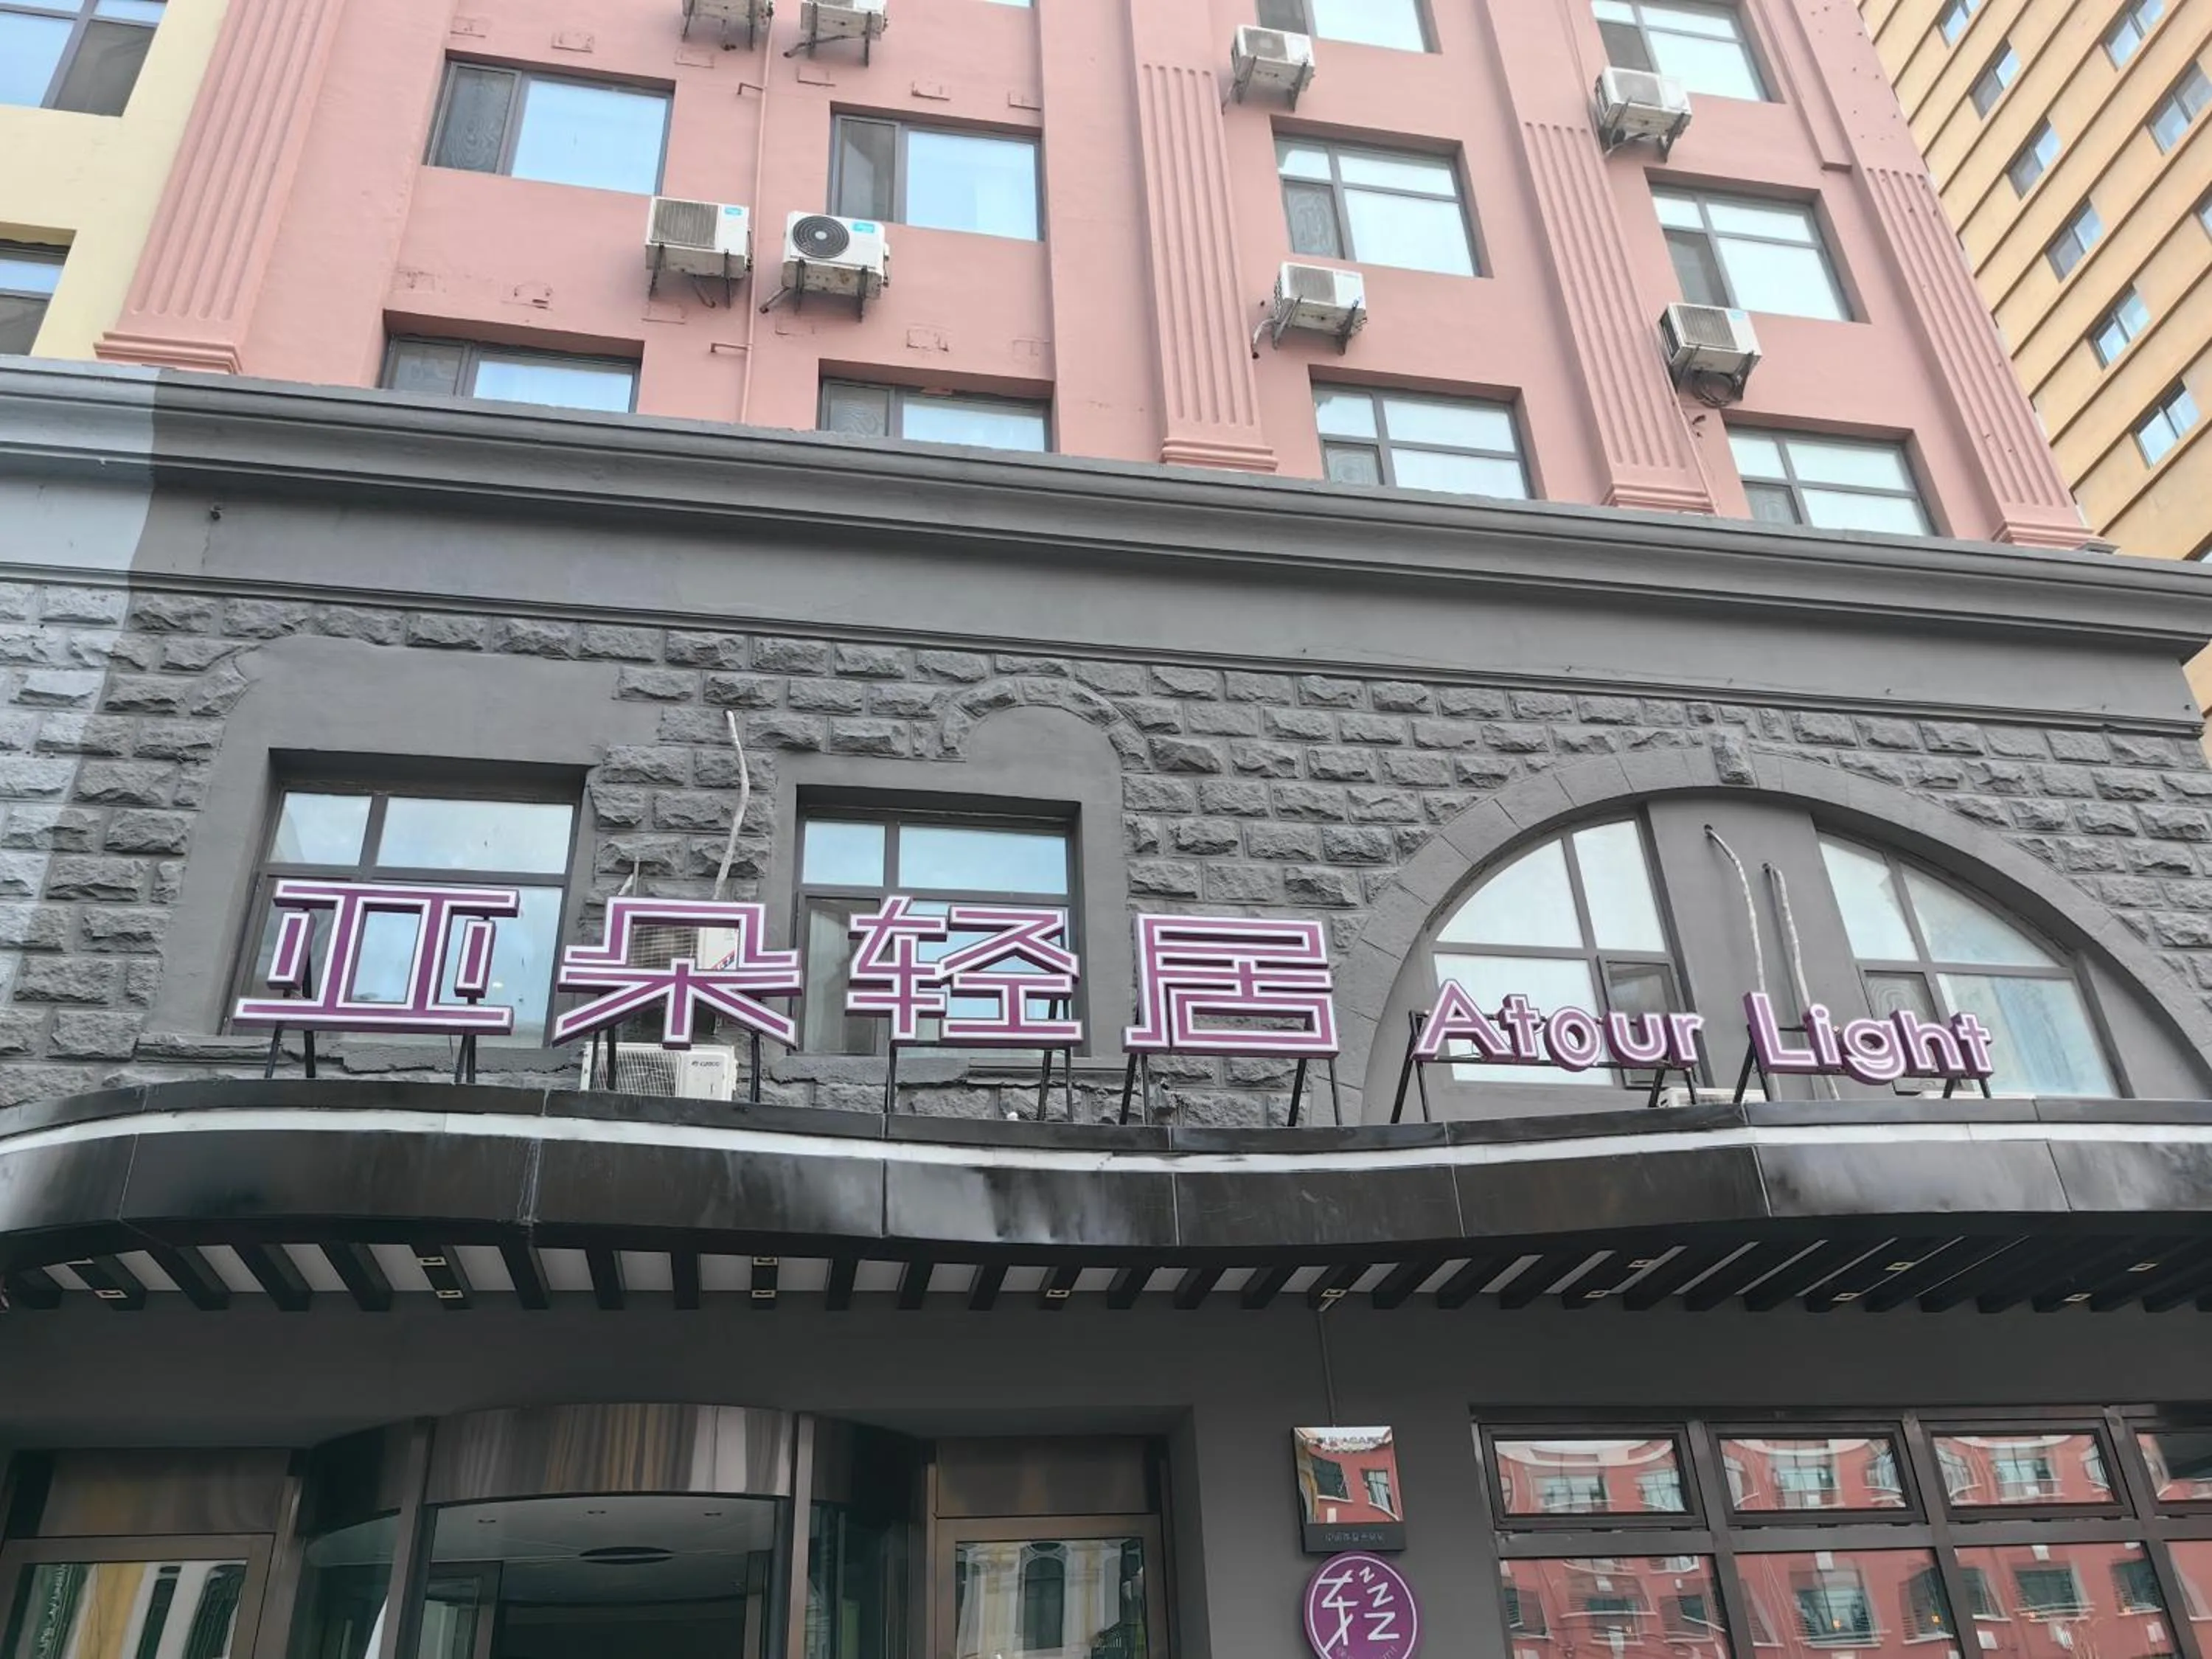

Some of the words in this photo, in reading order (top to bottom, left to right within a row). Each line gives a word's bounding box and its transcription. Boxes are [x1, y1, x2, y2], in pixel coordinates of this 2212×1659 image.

[233, 880, 1340, 1057] 亚朵轻居
[1413, 979, 1705, 1071] Atour
[1745, 990, 1994, 1084] Light
